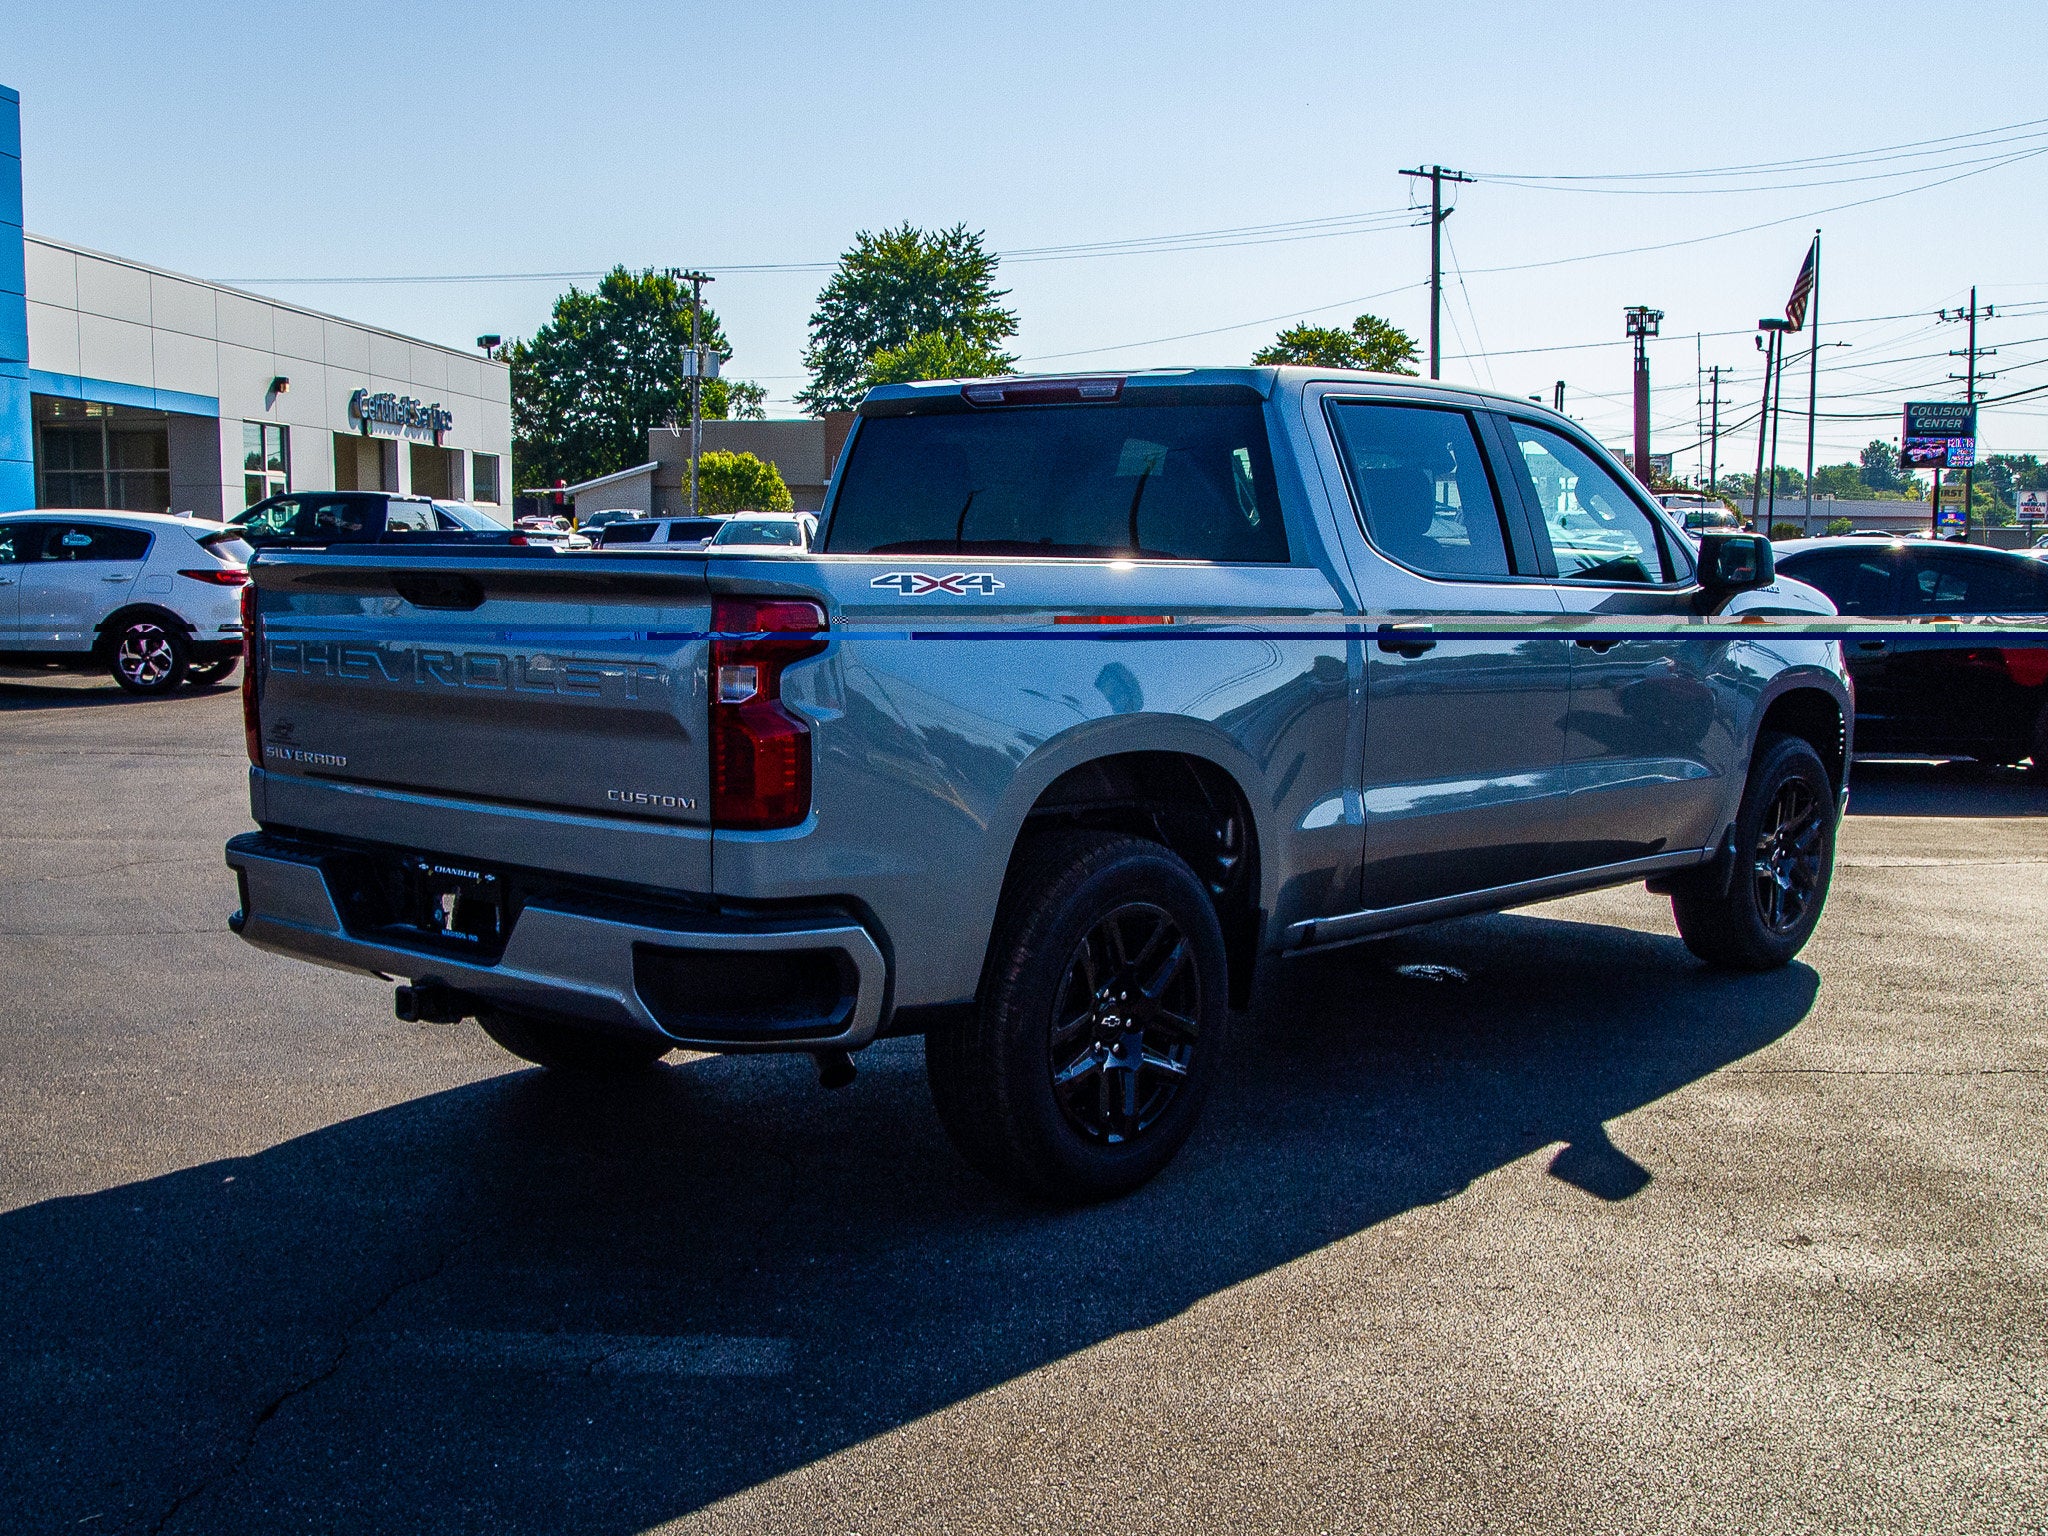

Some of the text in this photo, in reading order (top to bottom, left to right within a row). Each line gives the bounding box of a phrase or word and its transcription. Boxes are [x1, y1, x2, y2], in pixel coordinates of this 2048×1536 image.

[354, 388, 410, 425] Certified
[1910, 405, 1972, 416] COLLISION
[1916, 418, 1962, 428] CENTER
[1941, 489, 1964, 498] IRST
[268, 640, 661, 701] CHEVROLET
[265, 744, 347, 768] SILVERADO
[607, 789, 697, 810] CUSTOM
[434, 865, 480, 879] CHANDLER
